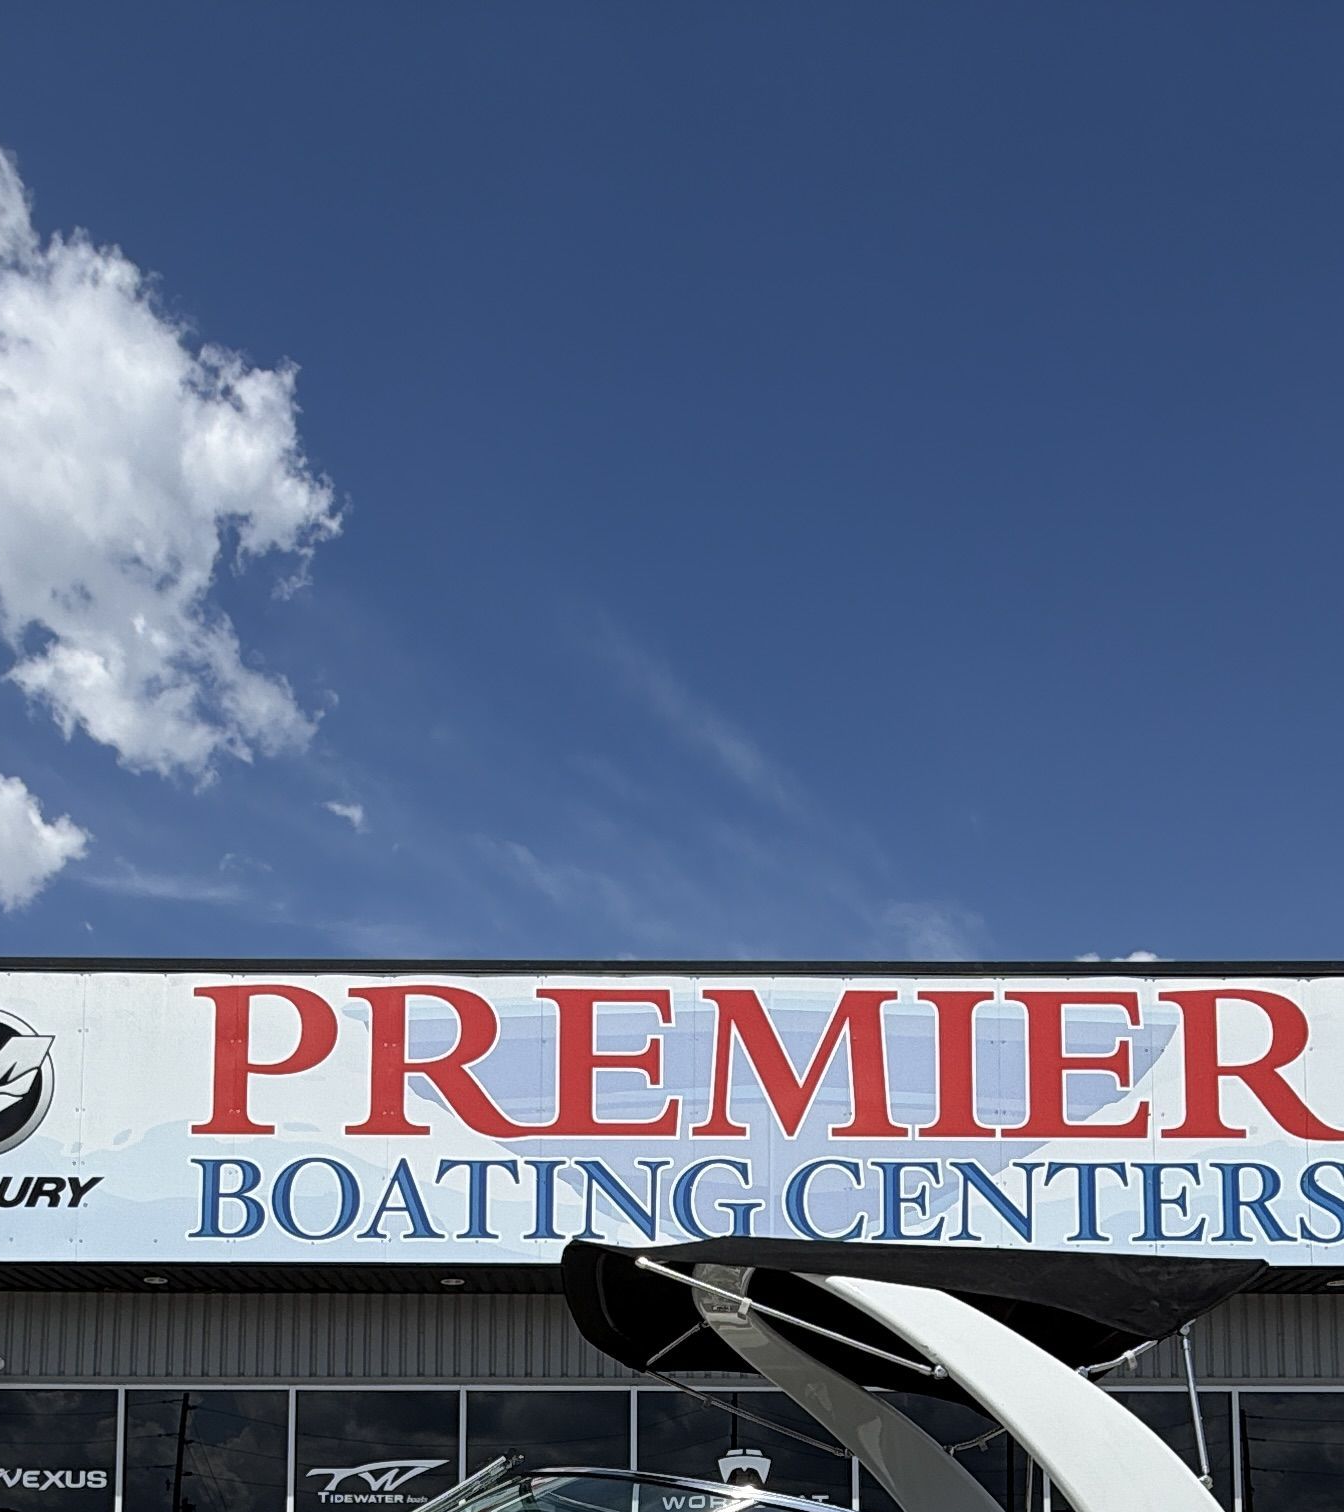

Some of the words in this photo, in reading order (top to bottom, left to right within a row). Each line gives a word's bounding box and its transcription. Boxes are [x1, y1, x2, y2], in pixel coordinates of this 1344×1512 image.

[189, 1160, 760, 1241] BOATING
[0, 1468, 108, 1491] VEXUS
[317, 1491, 404, 1504] TIDEWATER
